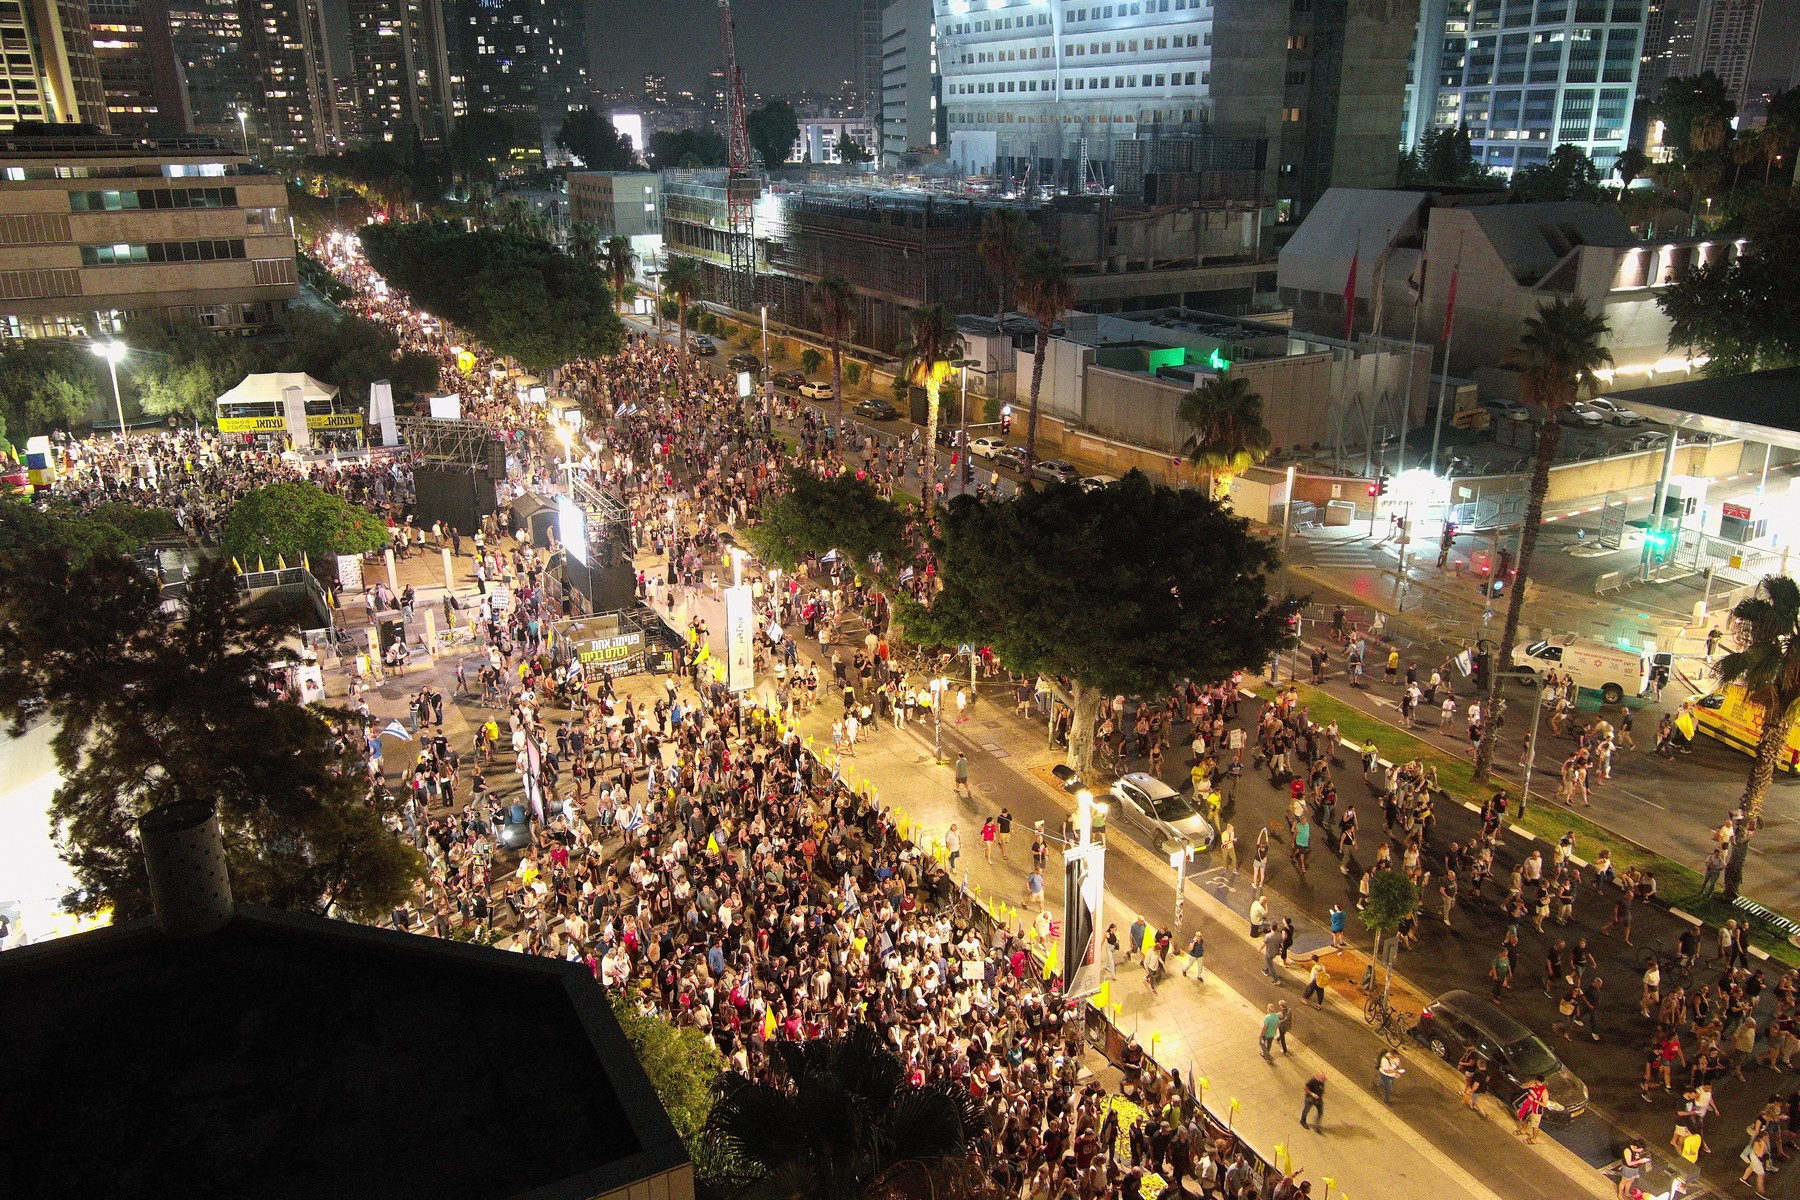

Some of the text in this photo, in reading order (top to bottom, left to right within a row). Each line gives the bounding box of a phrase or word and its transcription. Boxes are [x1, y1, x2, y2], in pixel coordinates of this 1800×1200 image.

[592, 634, 640, 650] פעימה אחת
[605, 646, 628, 659] וכולם
